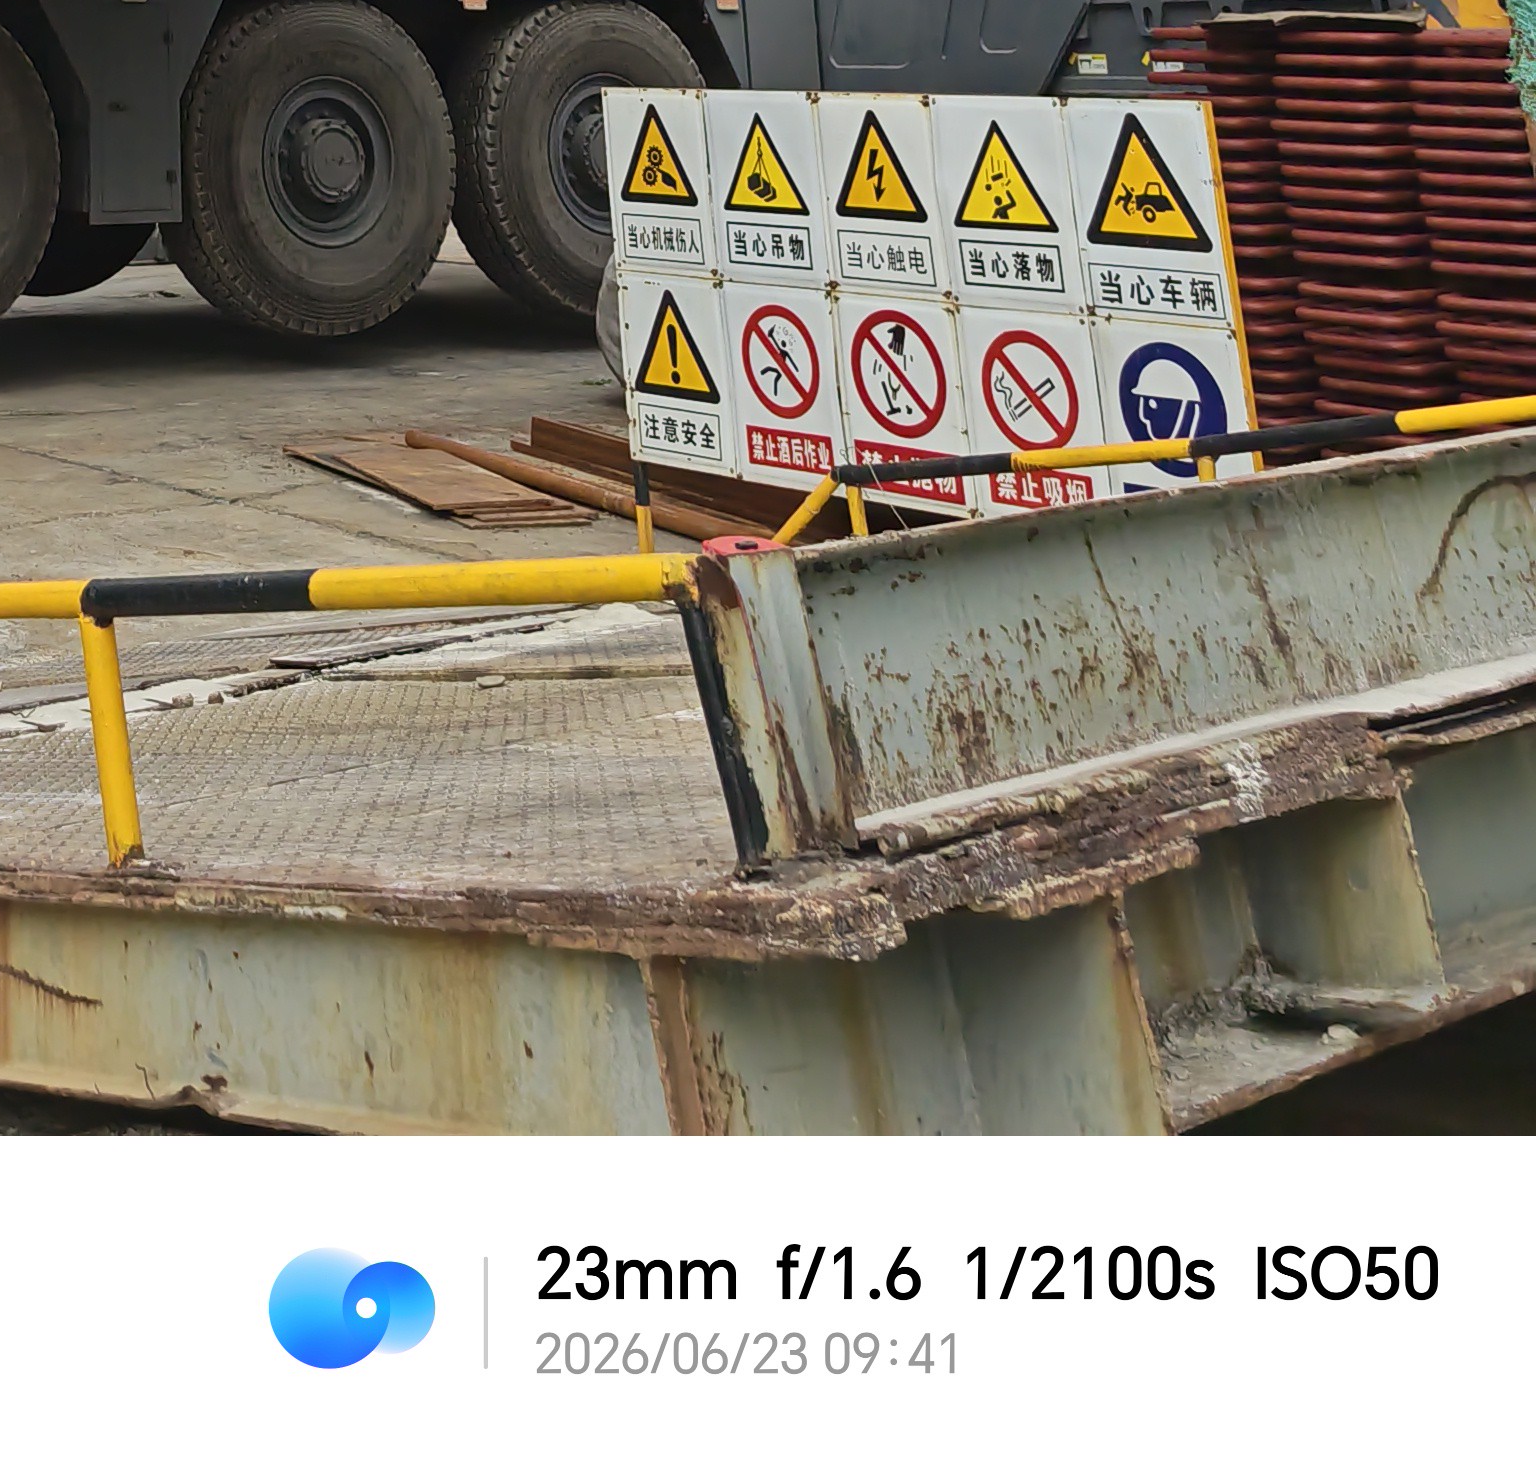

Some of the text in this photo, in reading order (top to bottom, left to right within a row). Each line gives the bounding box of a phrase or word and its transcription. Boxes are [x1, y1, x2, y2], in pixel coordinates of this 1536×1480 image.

[627, 223, 700, 255] 当心机械伤人
[733, 229, 805, 262] 当心吊物
[846, 241, 928, 275] 当心触电
[968, 247, 1056, 283] 当心落物
[1099, 269, 1218, 314] 当心车辆
[644, 413, 716, 450] 注意安全
[751, 430, 832, 470] 禁止酒后作业
[995, 471, 1087, 507] 禁止吸烟
